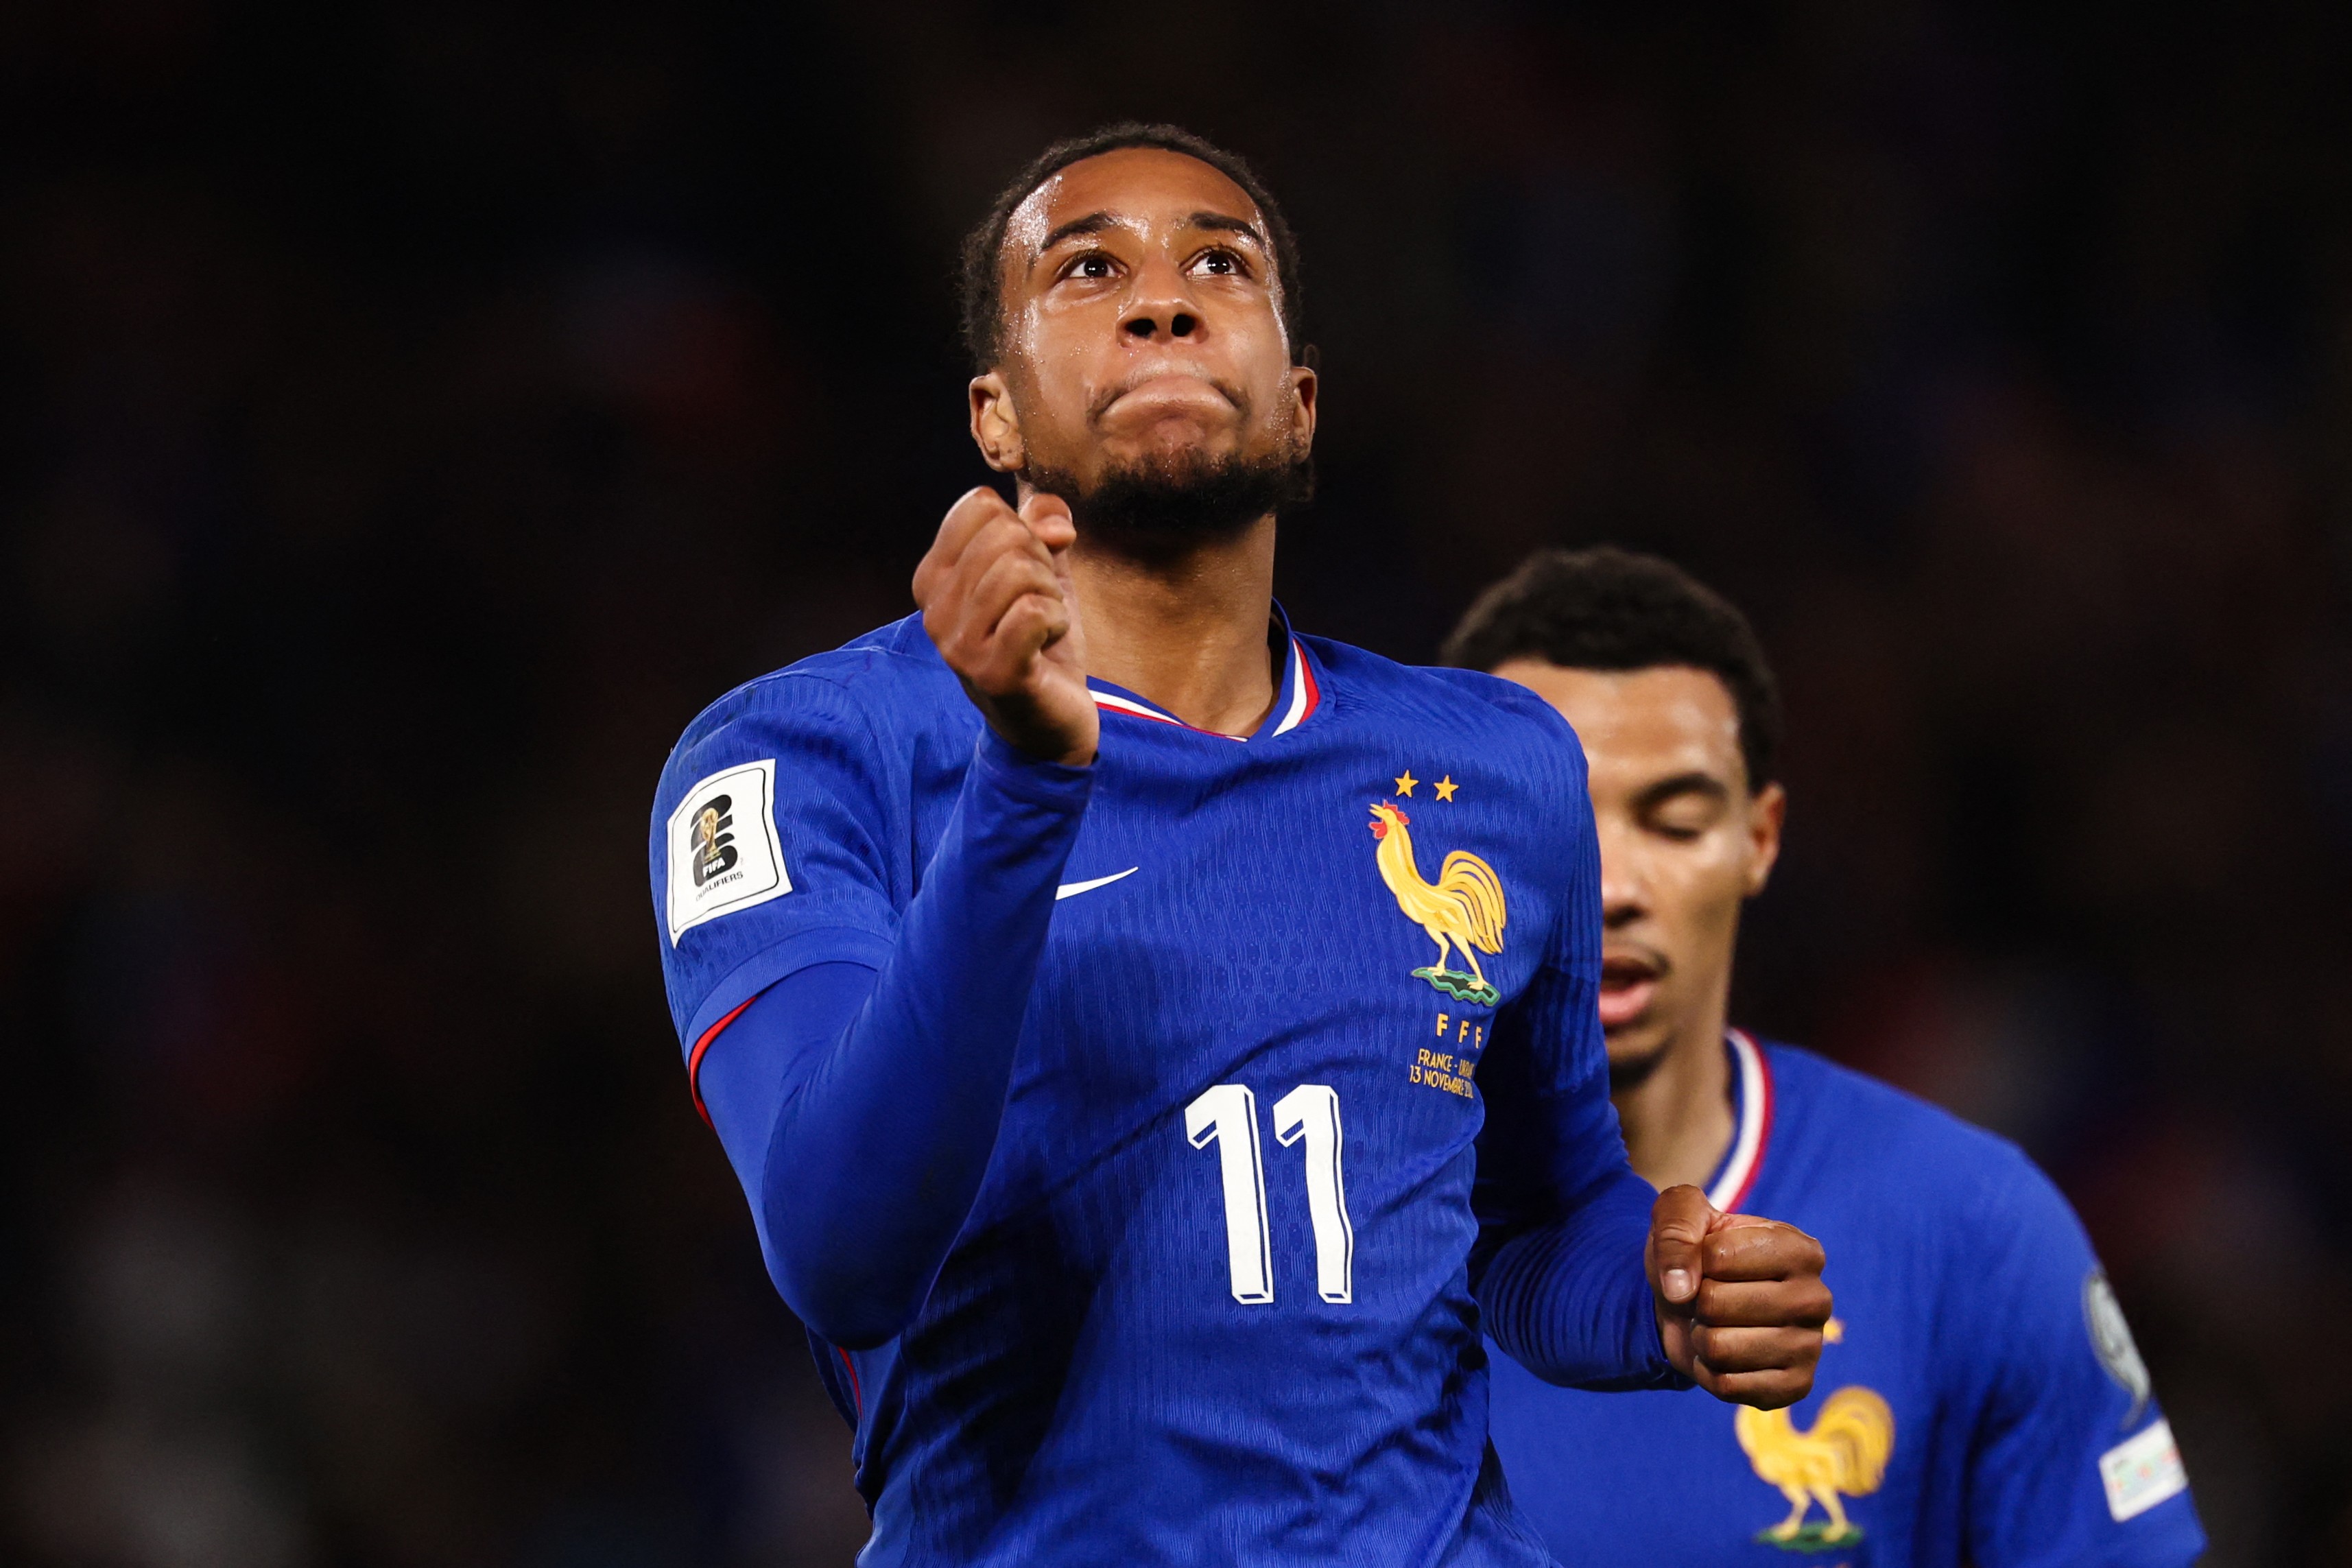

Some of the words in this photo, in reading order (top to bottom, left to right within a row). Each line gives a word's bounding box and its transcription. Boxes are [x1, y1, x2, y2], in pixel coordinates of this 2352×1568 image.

[703, 857, 726, 877] FIFA
[696, 871, 744, 902] QUALIFIERS
[1418, 1048, 1453, 1073] FRANCE
[1410, 1065, 1421, 1083] 13
[1423, 1070, 1464, 1096] NOVEMBRE
[1185, 1084, 1353, 1305] 11
